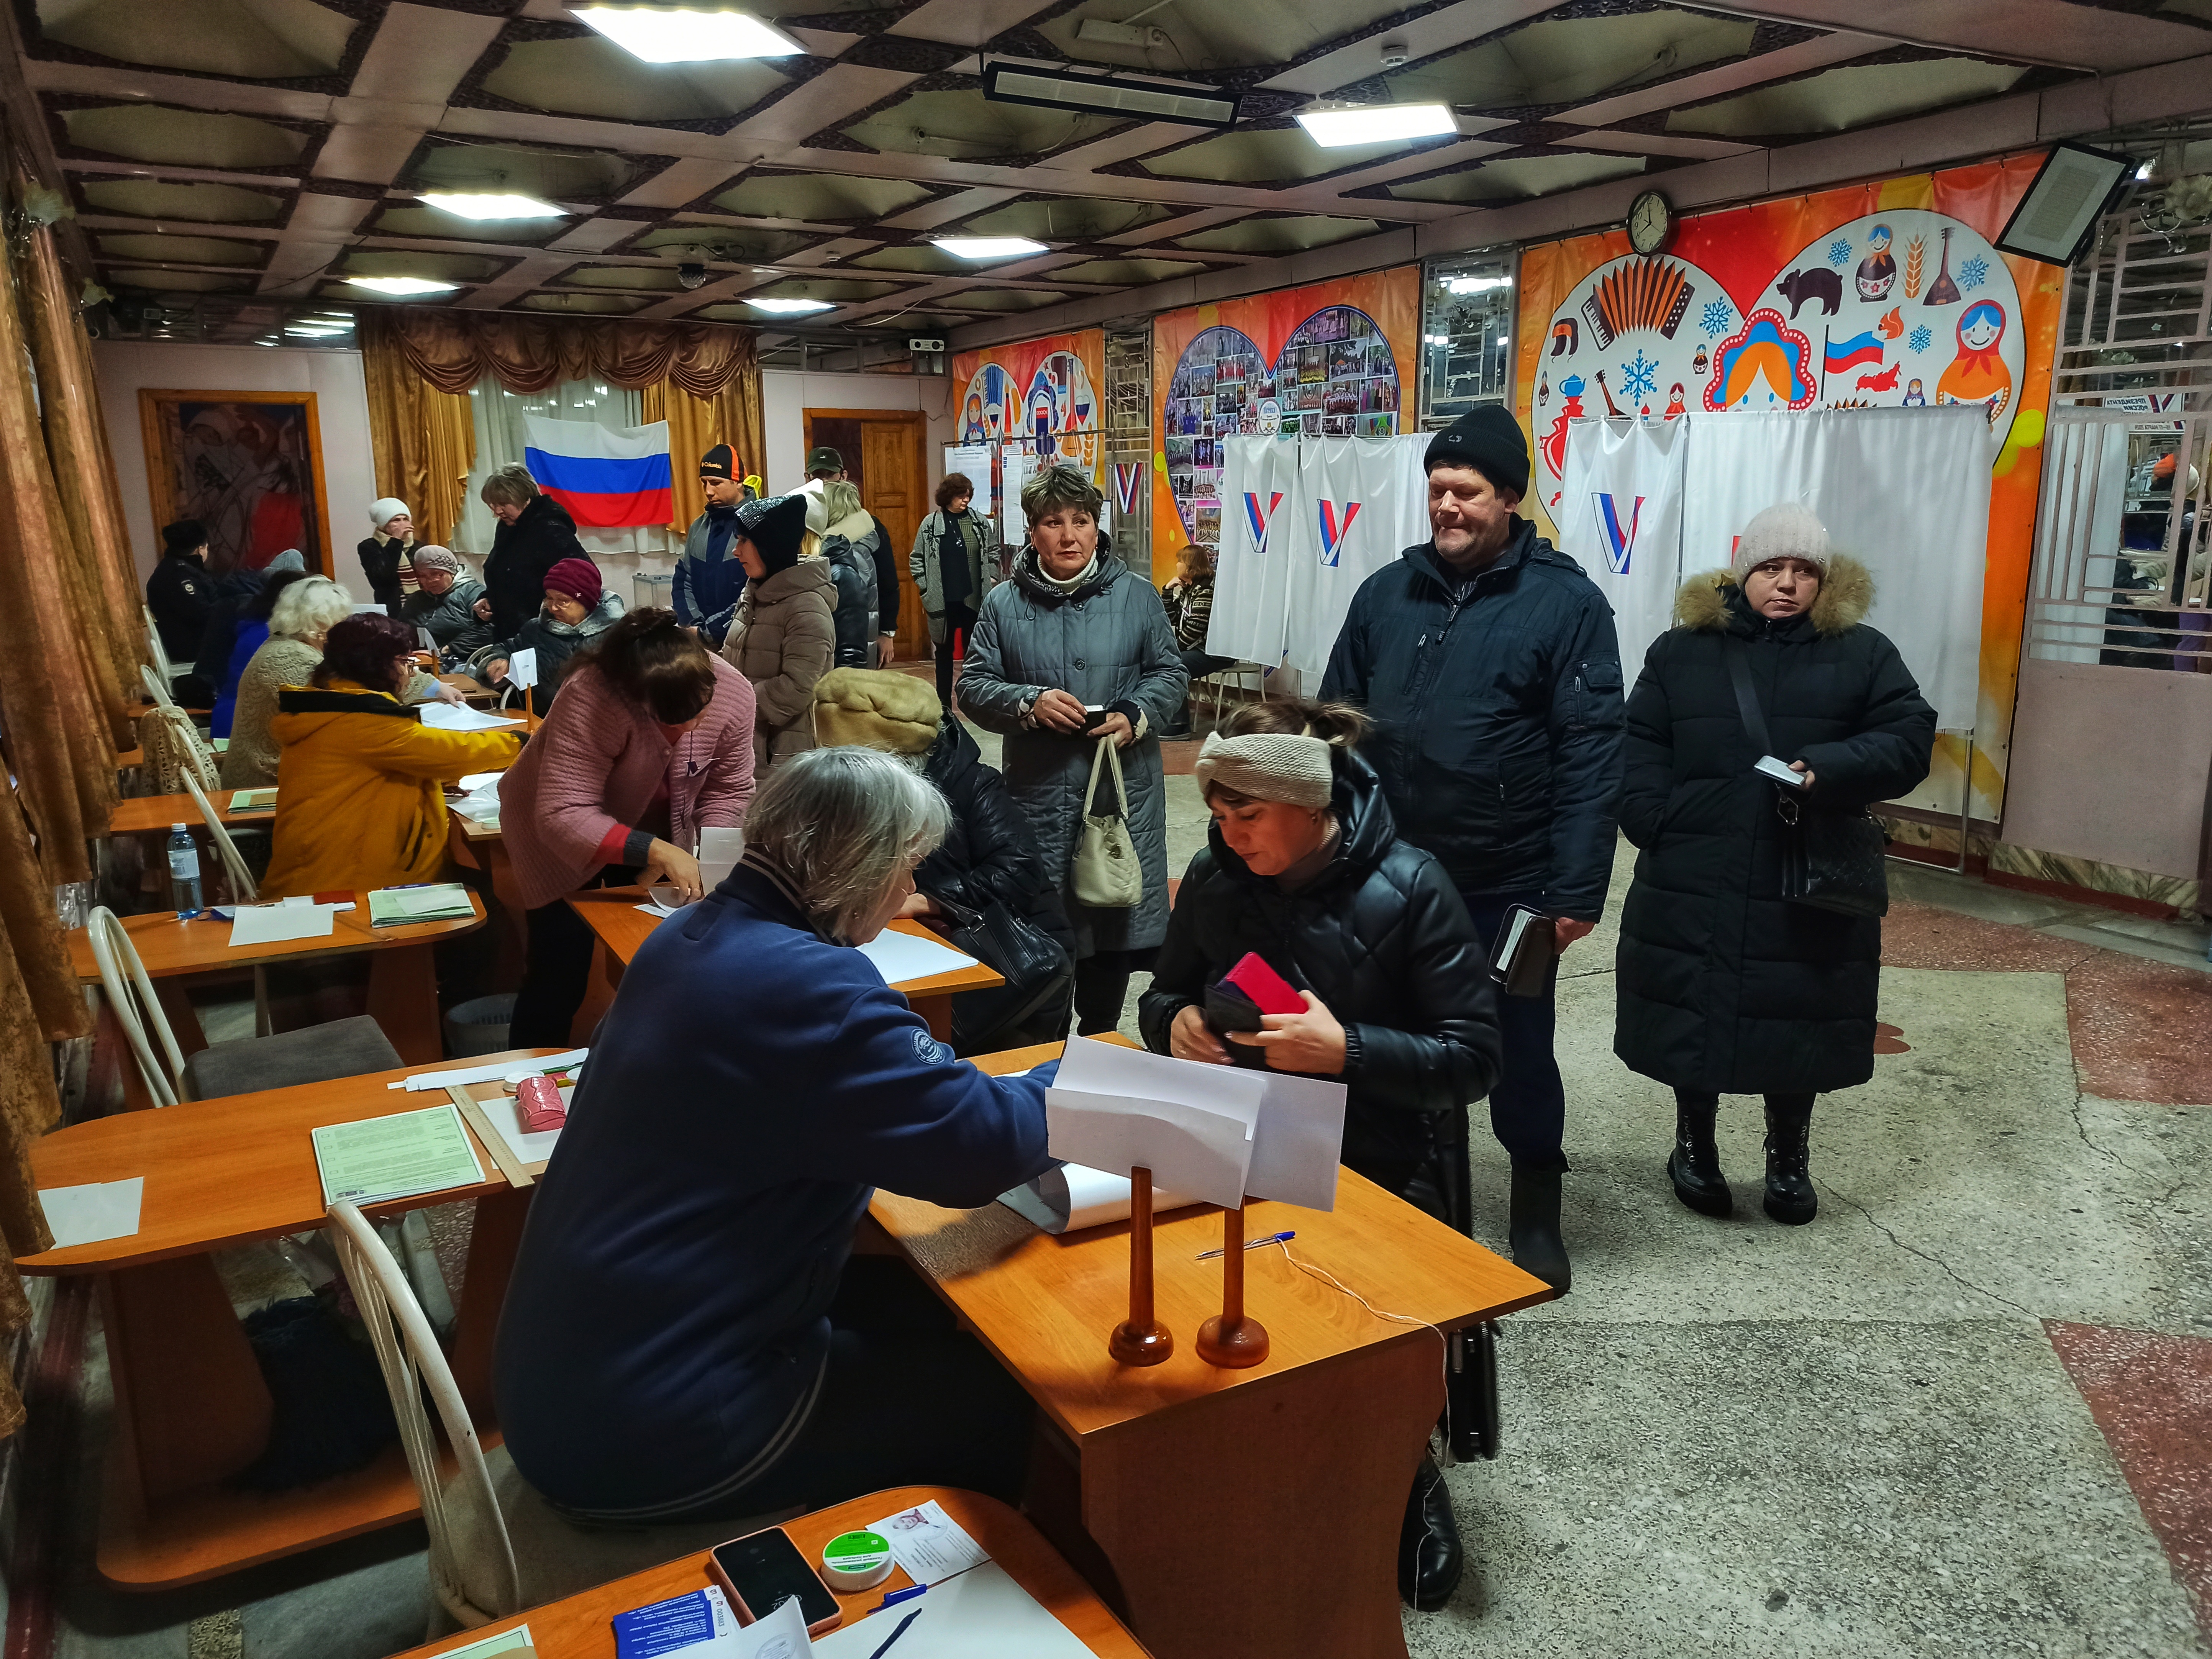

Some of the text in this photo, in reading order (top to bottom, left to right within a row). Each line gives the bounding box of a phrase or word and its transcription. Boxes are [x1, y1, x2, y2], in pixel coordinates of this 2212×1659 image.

[1647, 197, 1653, 205] 12
[1635, 212, 1643, 220] 10
[1634, 222, 1638, 230] 9
[1641, 239, 1646, 247] 7
